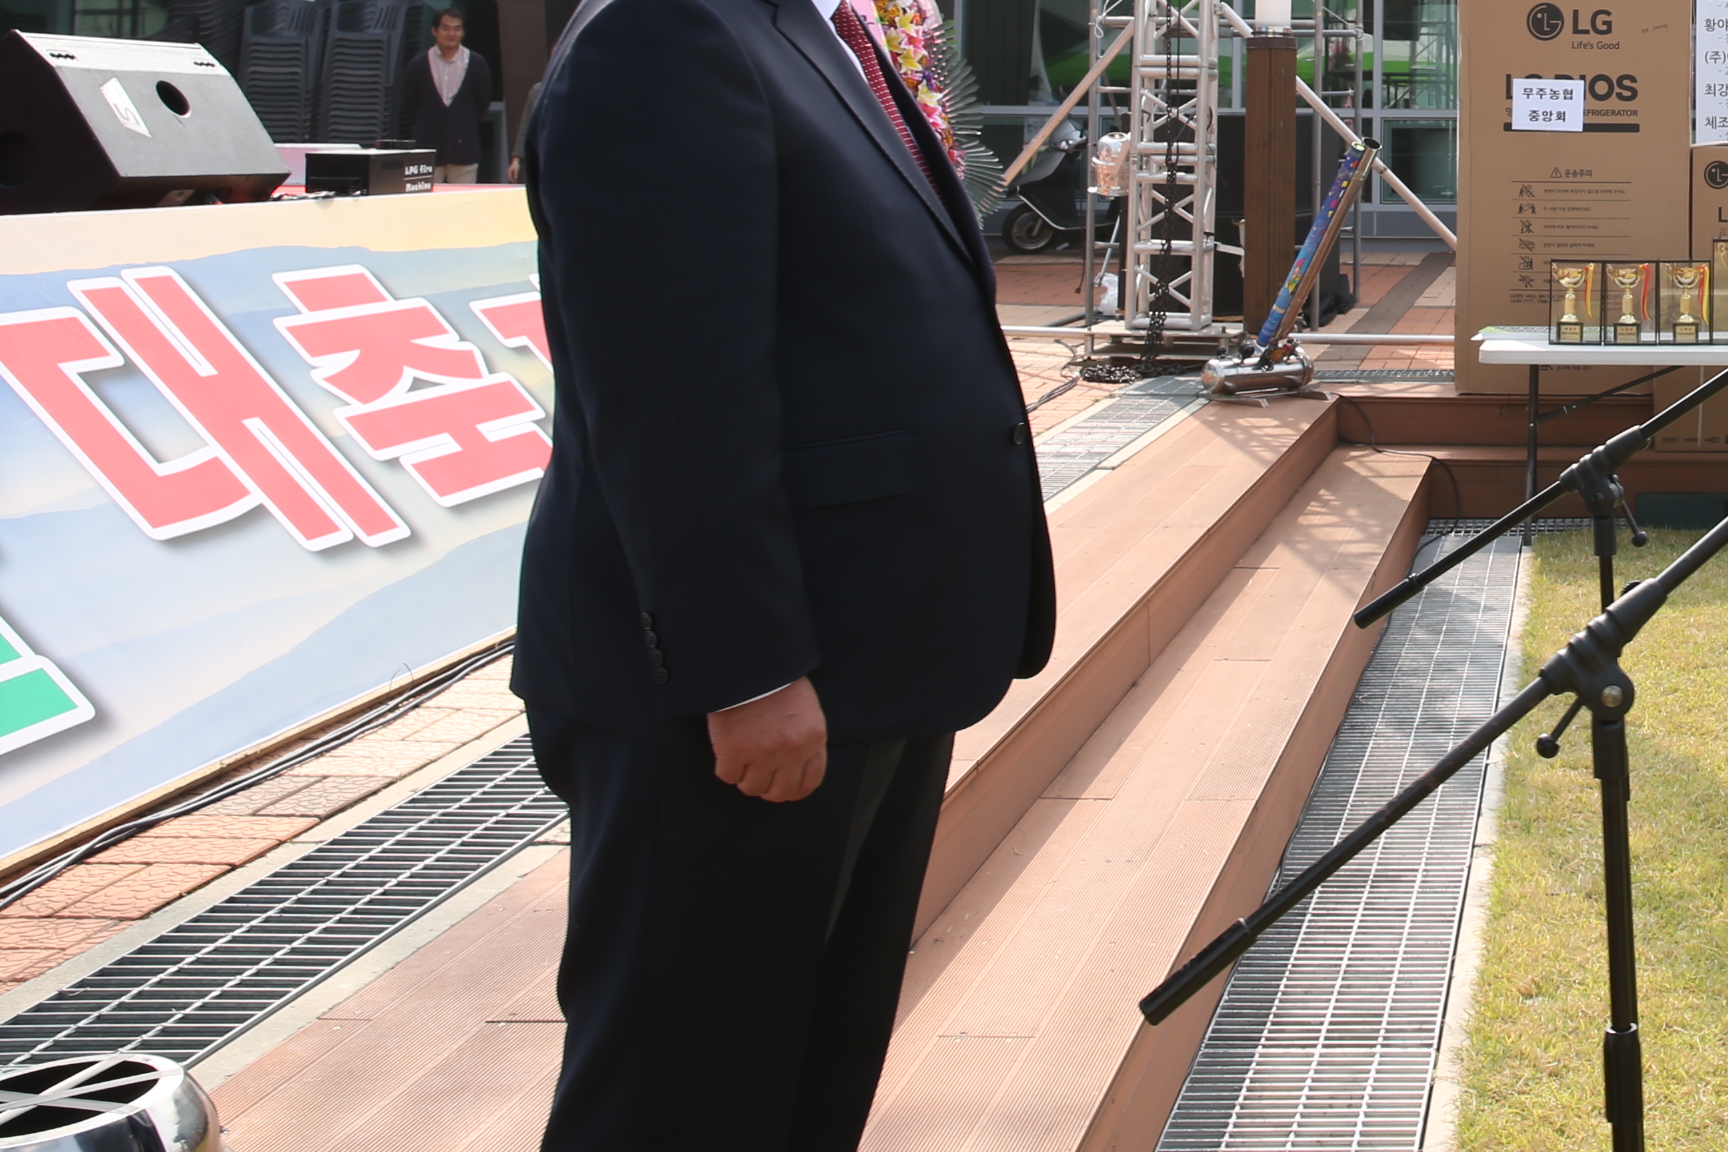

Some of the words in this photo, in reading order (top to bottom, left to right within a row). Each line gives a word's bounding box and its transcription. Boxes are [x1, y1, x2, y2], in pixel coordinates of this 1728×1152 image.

[1572, 9, 1612, 35] LG
[1572, 41, 1594, 50] Life's
[1597, 41, 1620, 50] Good
[1522, 88, 1573, 100] 무주농협
[1528, 110, 1566, 122] 중앙회
[1564, 169, 1592, 178] 운송주의
[0, 265, 554, 551] 대축
